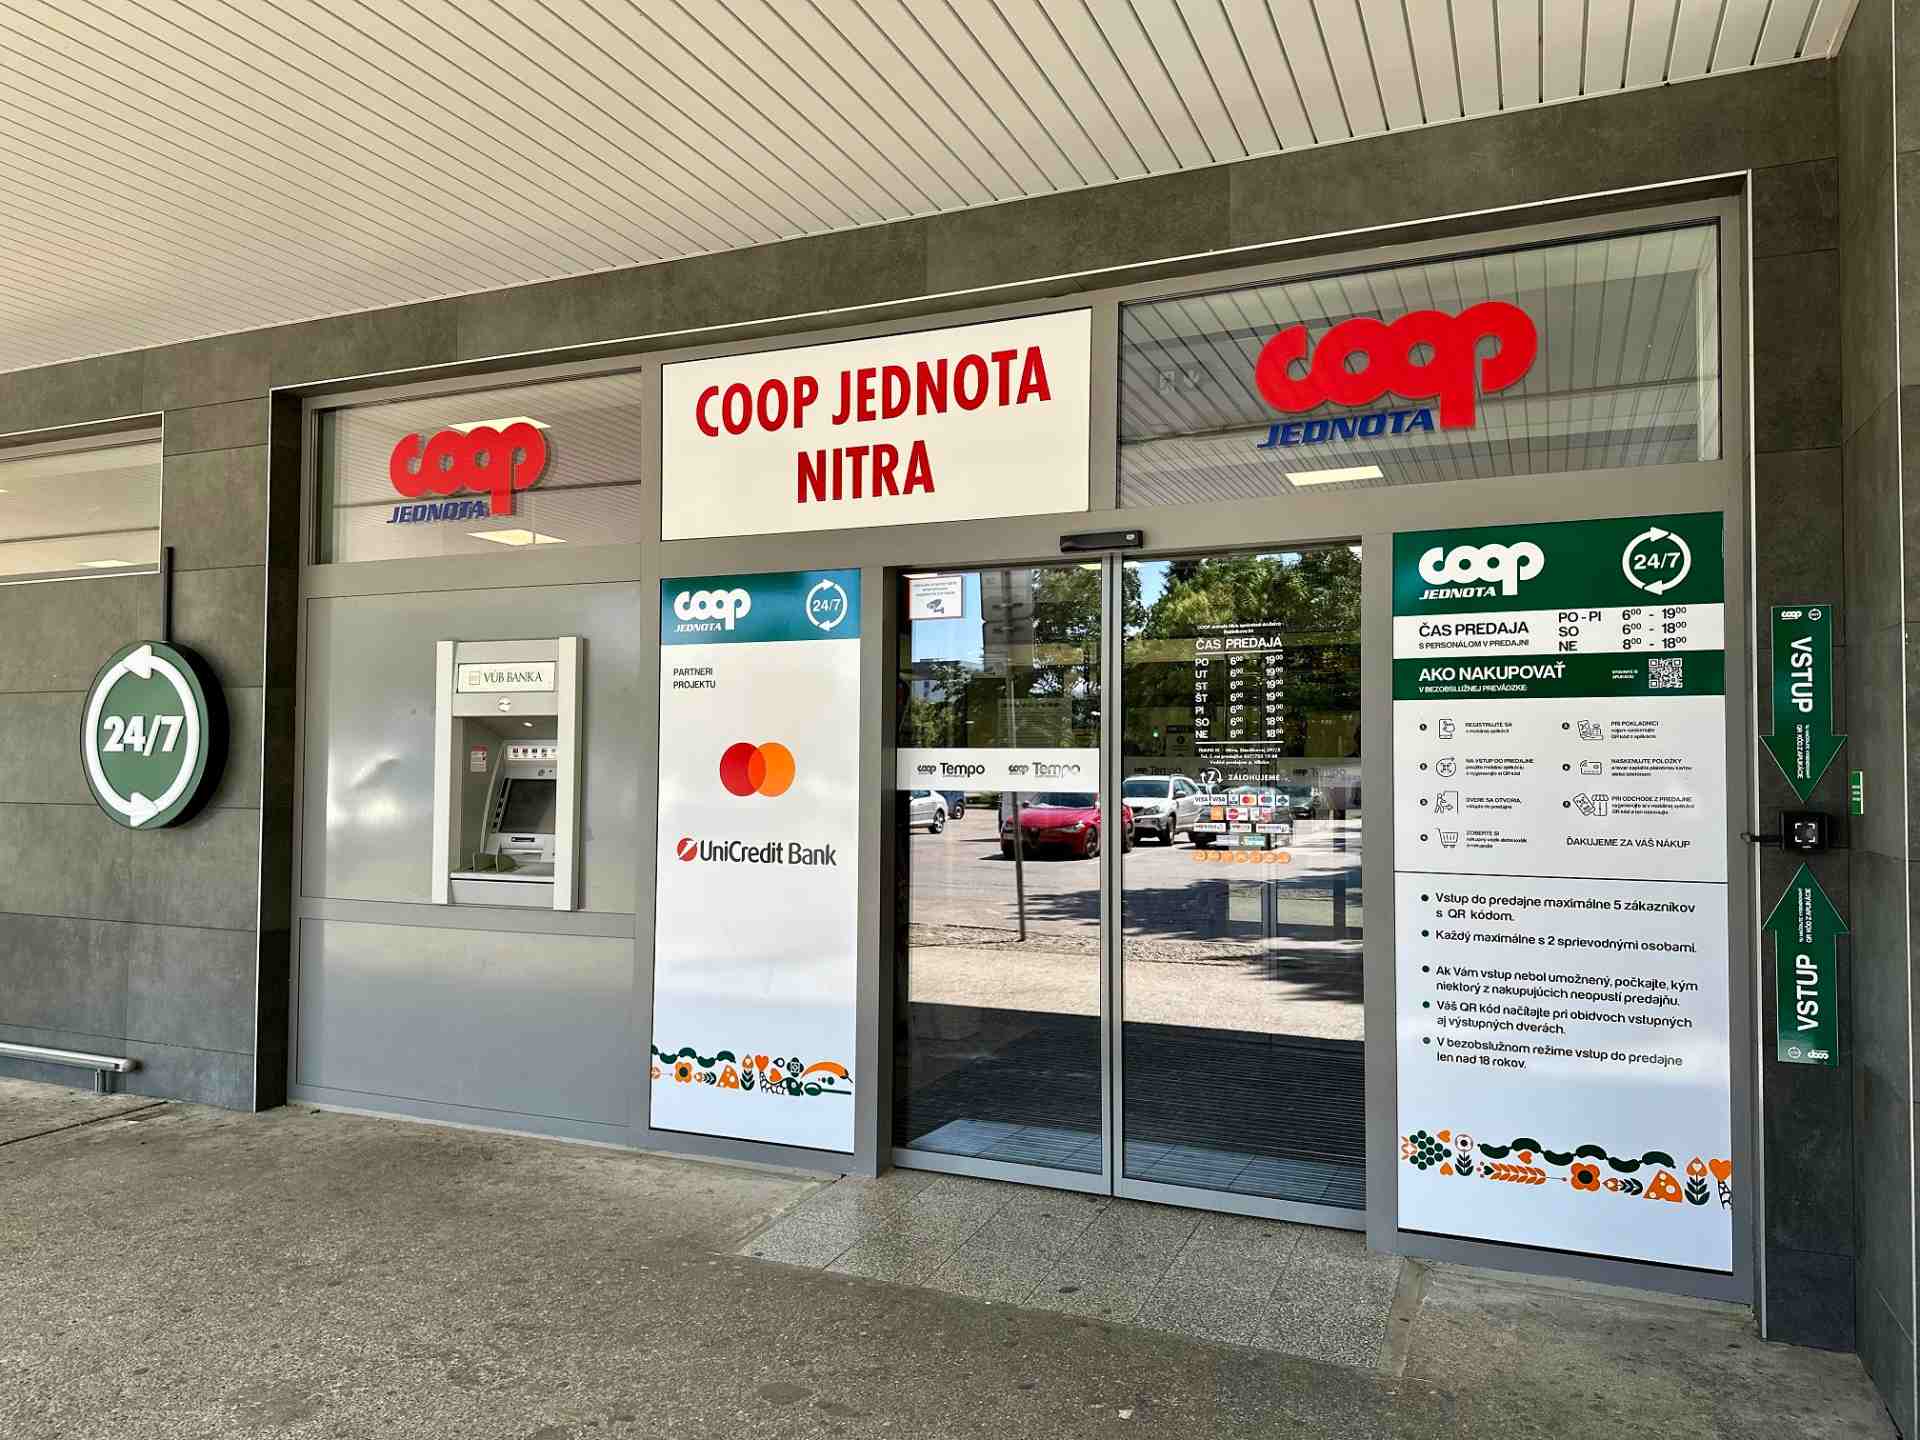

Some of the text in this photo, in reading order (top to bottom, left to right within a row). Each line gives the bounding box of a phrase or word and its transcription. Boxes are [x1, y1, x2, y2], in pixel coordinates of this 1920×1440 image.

[696, 345, 1051, 437] COOP JEDNOTA
[1256, 409, 1434, 449] JEDNOTA
[797, 440, 935, 504] NITRA
[386, 500, 487, 524] JEDNOTA
[1634, 553, 1681, 571] 24/7
[1419, 586, 1496, 600] JEDNOTA
[811, 599, 841, 612] 24/7
[1559, 612, 1578, 623] PO
[1589, 611, 1601, 622] PI
[673, 622, 722, 632] JEDNOTA
[1419, 621, 1529, 637] ČAS PREDAJA
[1559, 626, 1579, 637] SO
[1559, 641, 1578, 652] NE
[1195, 658, 1209, 666] PO
[506, 671, 543, 683] BANKA
[673, 668, 713, 676] PARTNERI
[1418, 661, 1566, 682] AKO NAKUPOVAŤ
[1790, 636, 1813, 713] VSTUP
[673, 680, 716, 689] PROJEKTU
[103, 715, 187, 756] 24/7
[1195, 730, 1208, 739] NE
[940, 762, 985, 778] Tempo
[1620, 838, 1633, 847] ZA
[700, 840, 837, 866] UniCredit Bank
[1436, 893, 1696, 913] Vstup do predajne maximálne 5 zákazníkov
[1436, 909, 1515, 921] s QR kódom.
[1436, 930, 1696, 953] Každý maximálne s 2 sprievodnými osobami.
[1436, 966, 1451, 976] Ak
[1454, 967, 1479, 978] Vám
[1481, 970, 1512, 981] vstup
[1514, 971, 1546, 982] nebol
[1671, 980, 1698, 993] kým
[1436, 982, 1481, 994] niektorý
[1484, 985, 1490, 993] z
[1492, 984, 1568, 999] nakupujúcich
[1570, 990, 1622, 1002] neopustí
[1796, 954, 1819, 1032] VSTUP
[1437, 1000, 1692, 1029] Váš QR kód načítajte pri obidvoch vstupných
[1437, 1017, 1447, 1028] aj
[1449, 1017, 1514, 1031] výstupných
[1437, 1037, 1683, 1068] V bezobslužnom režime vstup do predajne
[1437, 1052, 1527, 1069] len nad 18 rokov.
